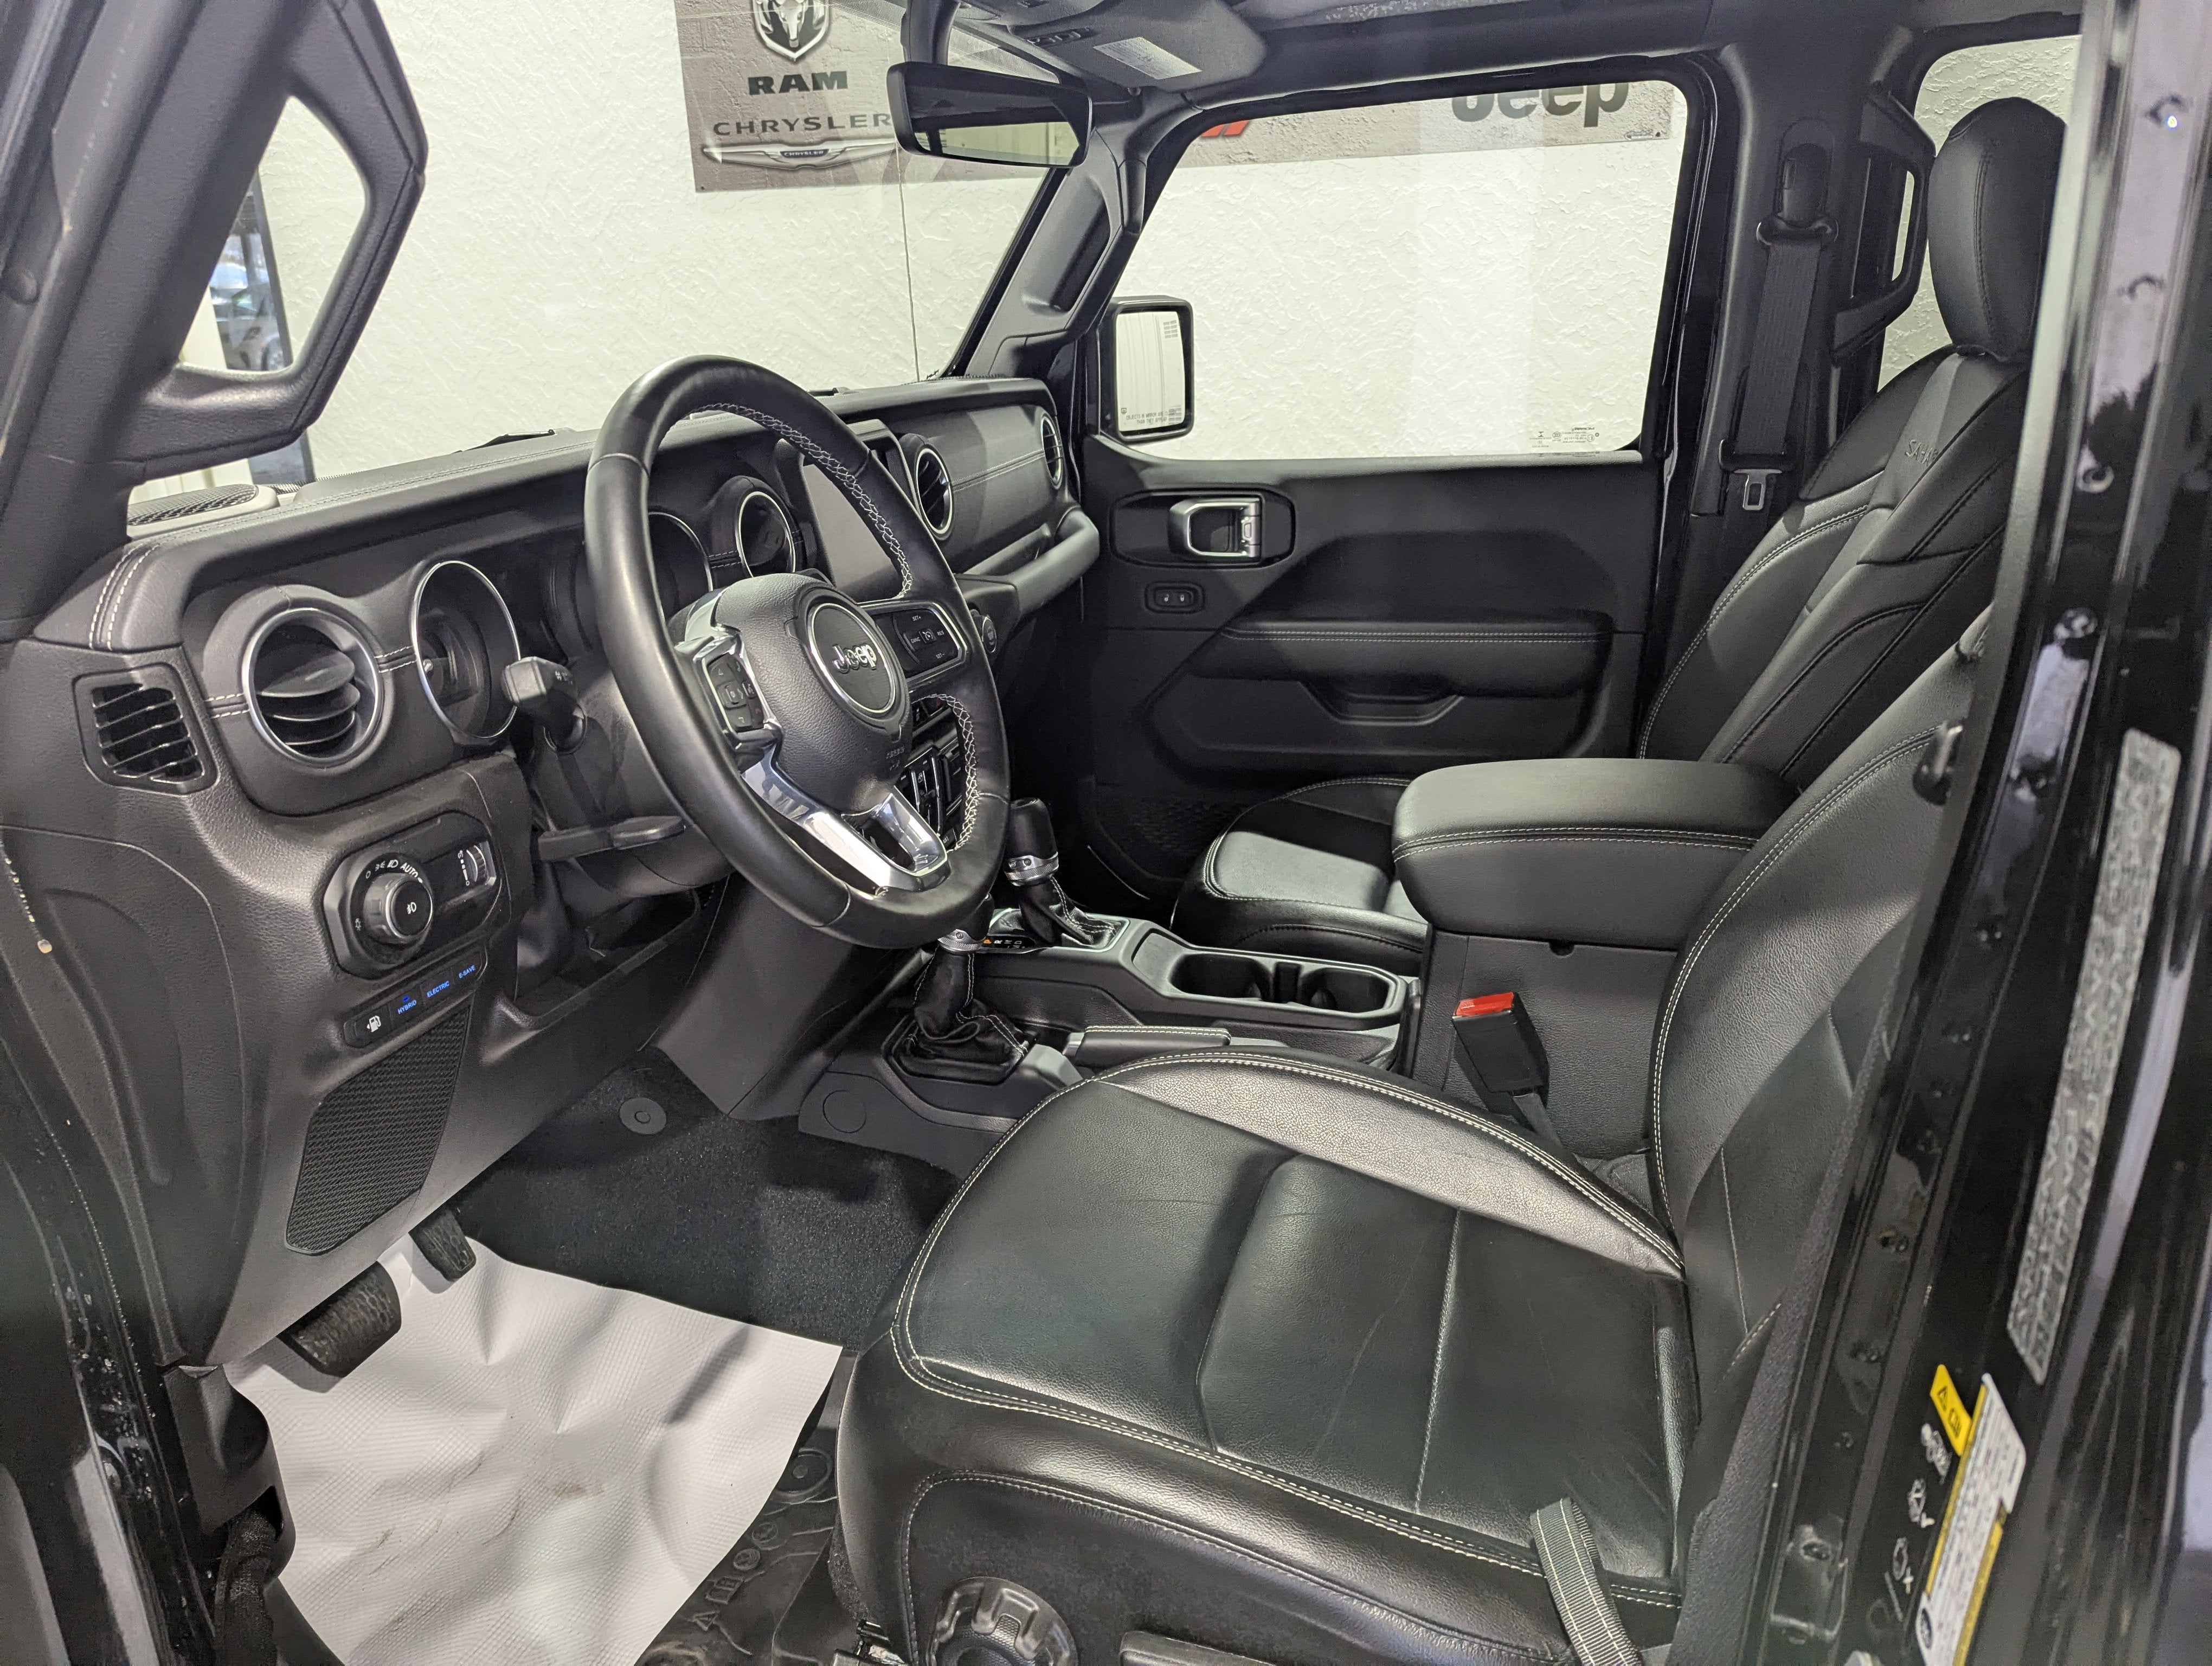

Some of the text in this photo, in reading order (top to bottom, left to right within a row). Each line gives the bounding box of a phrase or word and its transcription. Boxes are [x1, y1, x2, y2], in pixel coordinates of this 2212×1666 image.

[748, 71, 848, 95] RAM
[713, 113, 893, 136] CHRYSLER
[832, 643, 877, 674] Jeep
[459, 965, 476, 979] E-SAVE
[427, 981, 450, 997] ELECTRIC
[397, 1000, 417, 1014] HYBRID
